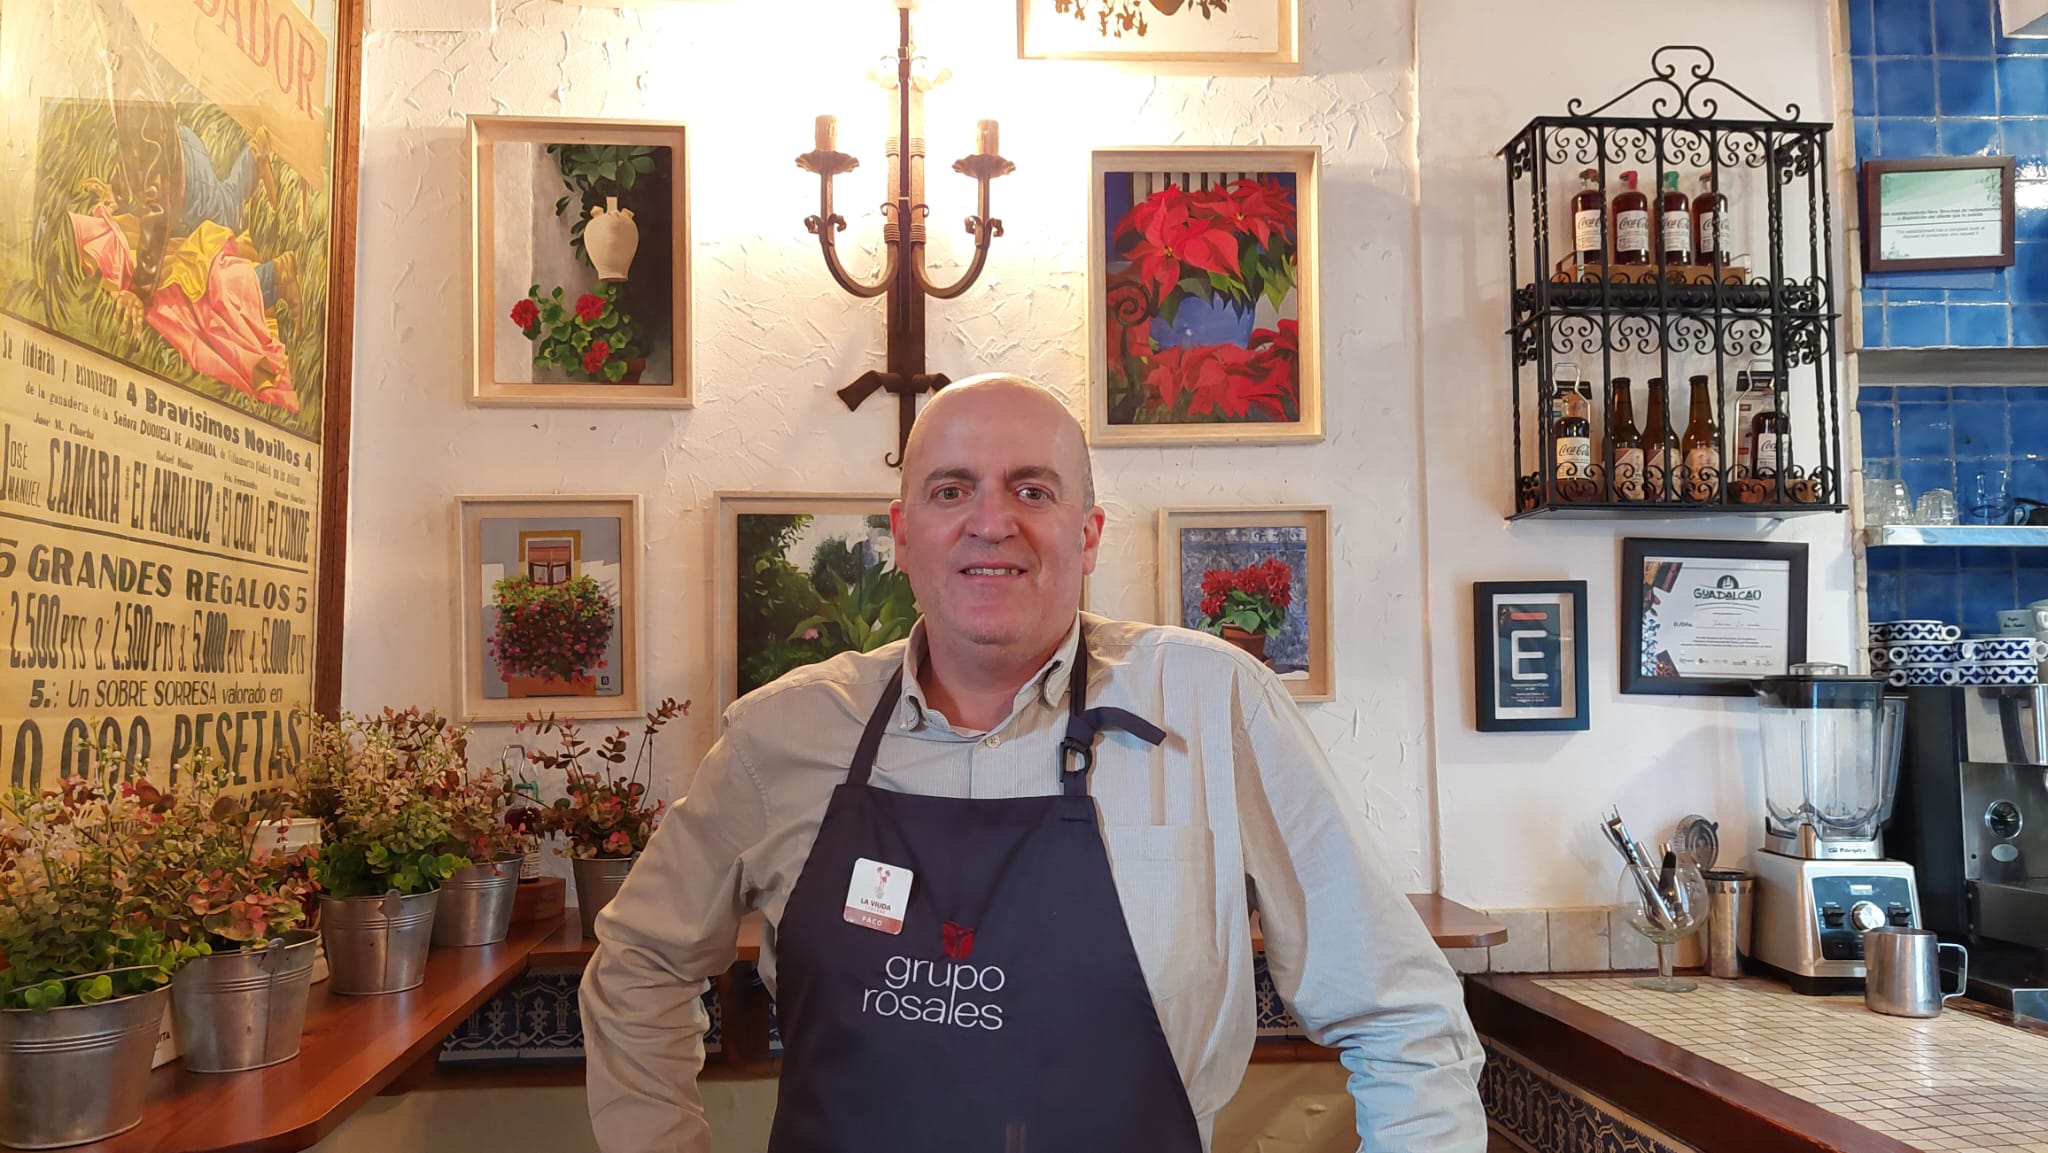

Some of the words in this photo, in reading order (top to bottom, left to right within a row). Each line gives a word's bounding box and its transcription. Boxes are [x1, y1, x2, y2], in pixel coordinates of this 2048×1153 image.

[126, 381, 137, 407] 4
[244, 426, 300, 468] Novillos
[303, 451, 312, 472] 4
[140, 419, 171, 443] DUQUESA
[8, 475, 41, 508] MANUEL
[47, 437, 120, 524] CAMARA
[149, 467, 213, 544] ANDALUZ
[0, 537, 19, 578] 5
[27, 543, 173, 598] GRANDES
[186, 568, 291, 612] REGALOS
[295, 586, 308, 614] 5
[60, 614, 87, 670] PTS
[152, 621, 175, 672] PTS
[68, 679, 89, 708] Un
[94, 679, 148, 707] SOBRE
[222, 681, 267, 704] valorado
[270, 686, 283, 703] en
[169, 709, 302, 788] PESETAS
[860, 898, 868, 906] LA
[871, 900, 891, 911] VIUDA
[862, 916, 882, 926] PACO
[885, 955, 1005, 998] grupo
[862, 984, 1003, 1030] rosales
